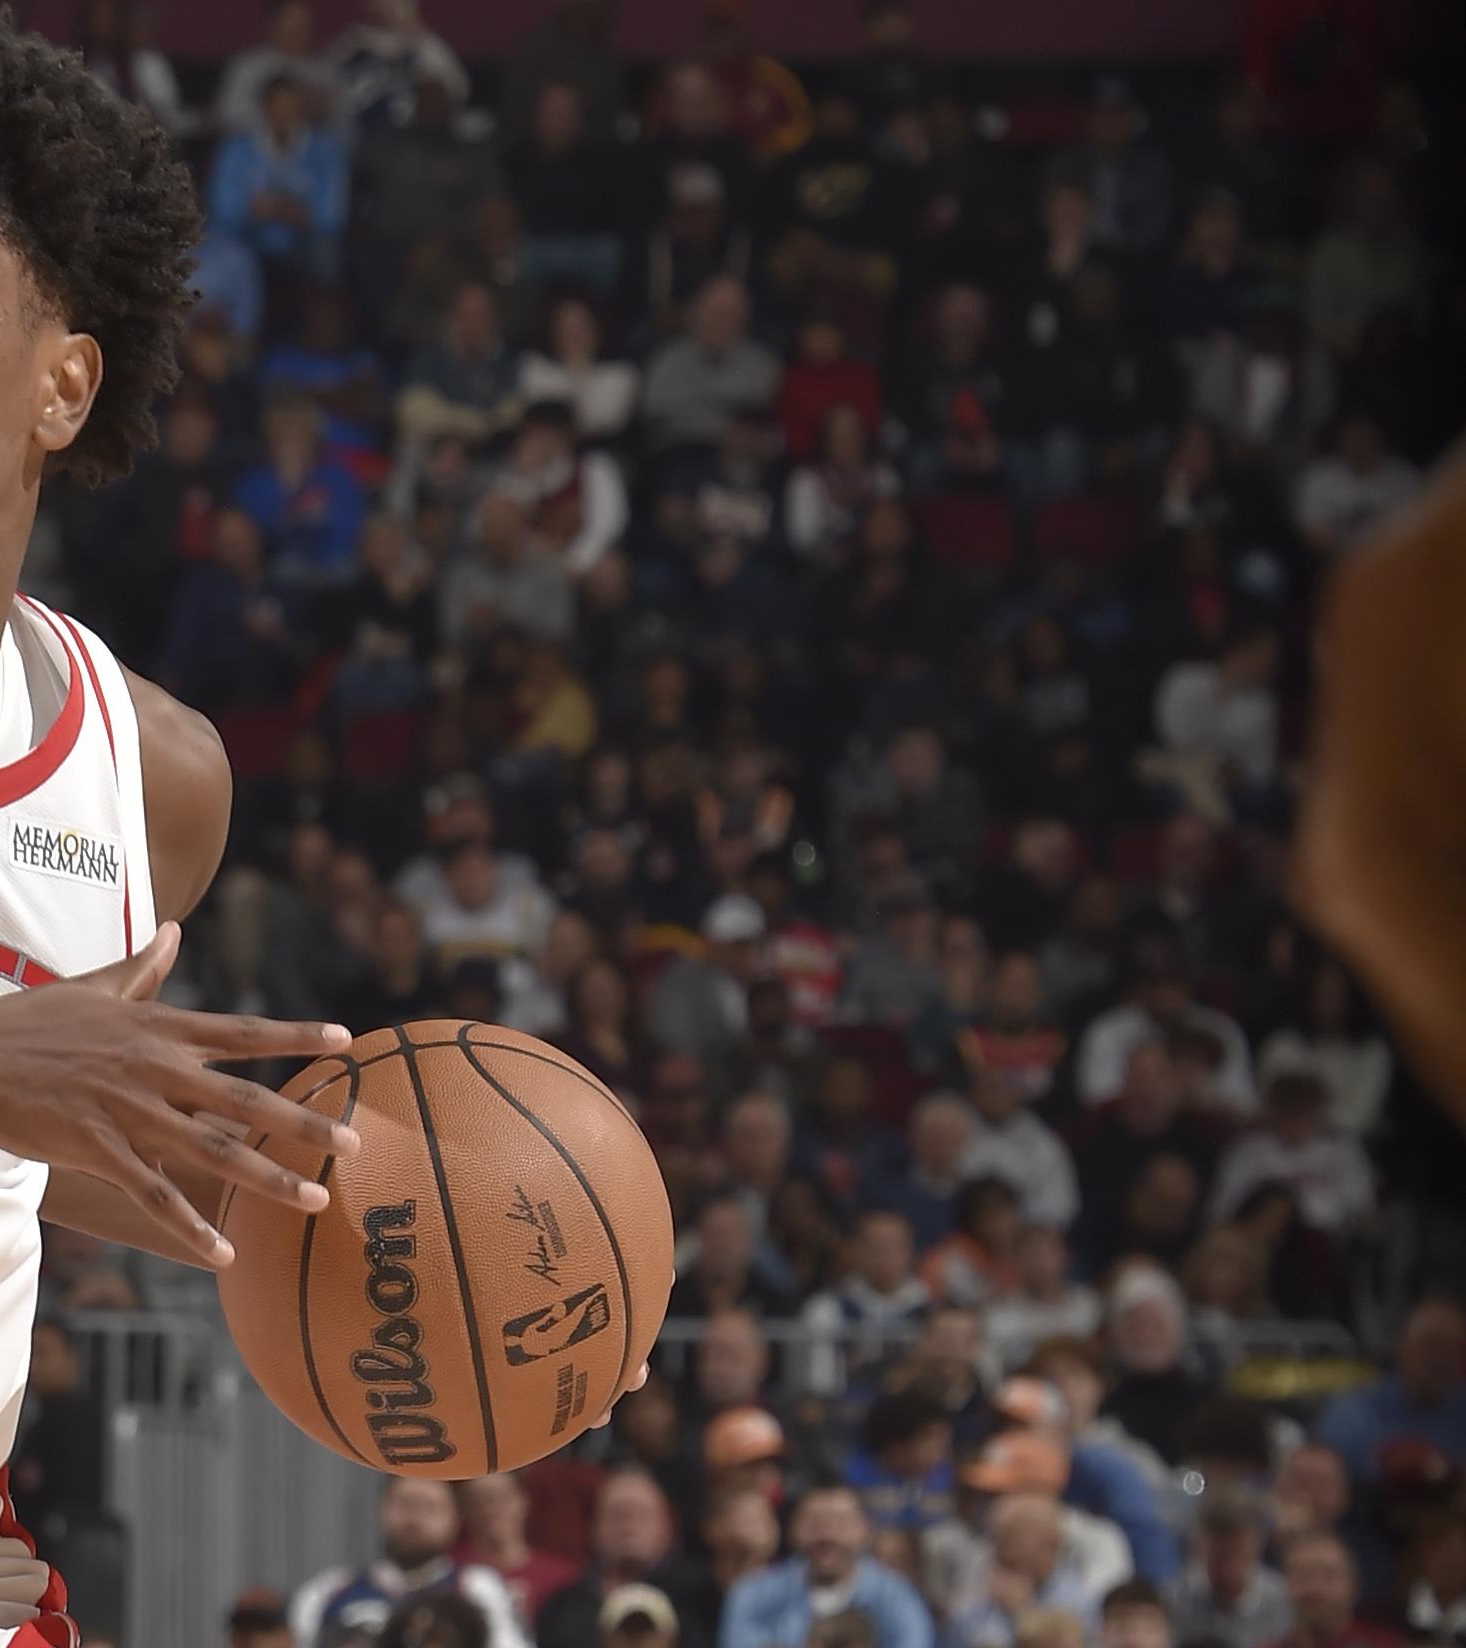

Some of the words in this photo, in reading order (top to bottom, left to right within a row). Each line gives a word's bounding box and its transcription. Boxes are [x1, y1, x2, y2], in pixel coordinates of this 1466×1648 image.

[13, 822, 119, 867] MEMORIAL
[13, 838, 119, 885] HERMANN
[349, 1199, 458, 1466] Wilson
